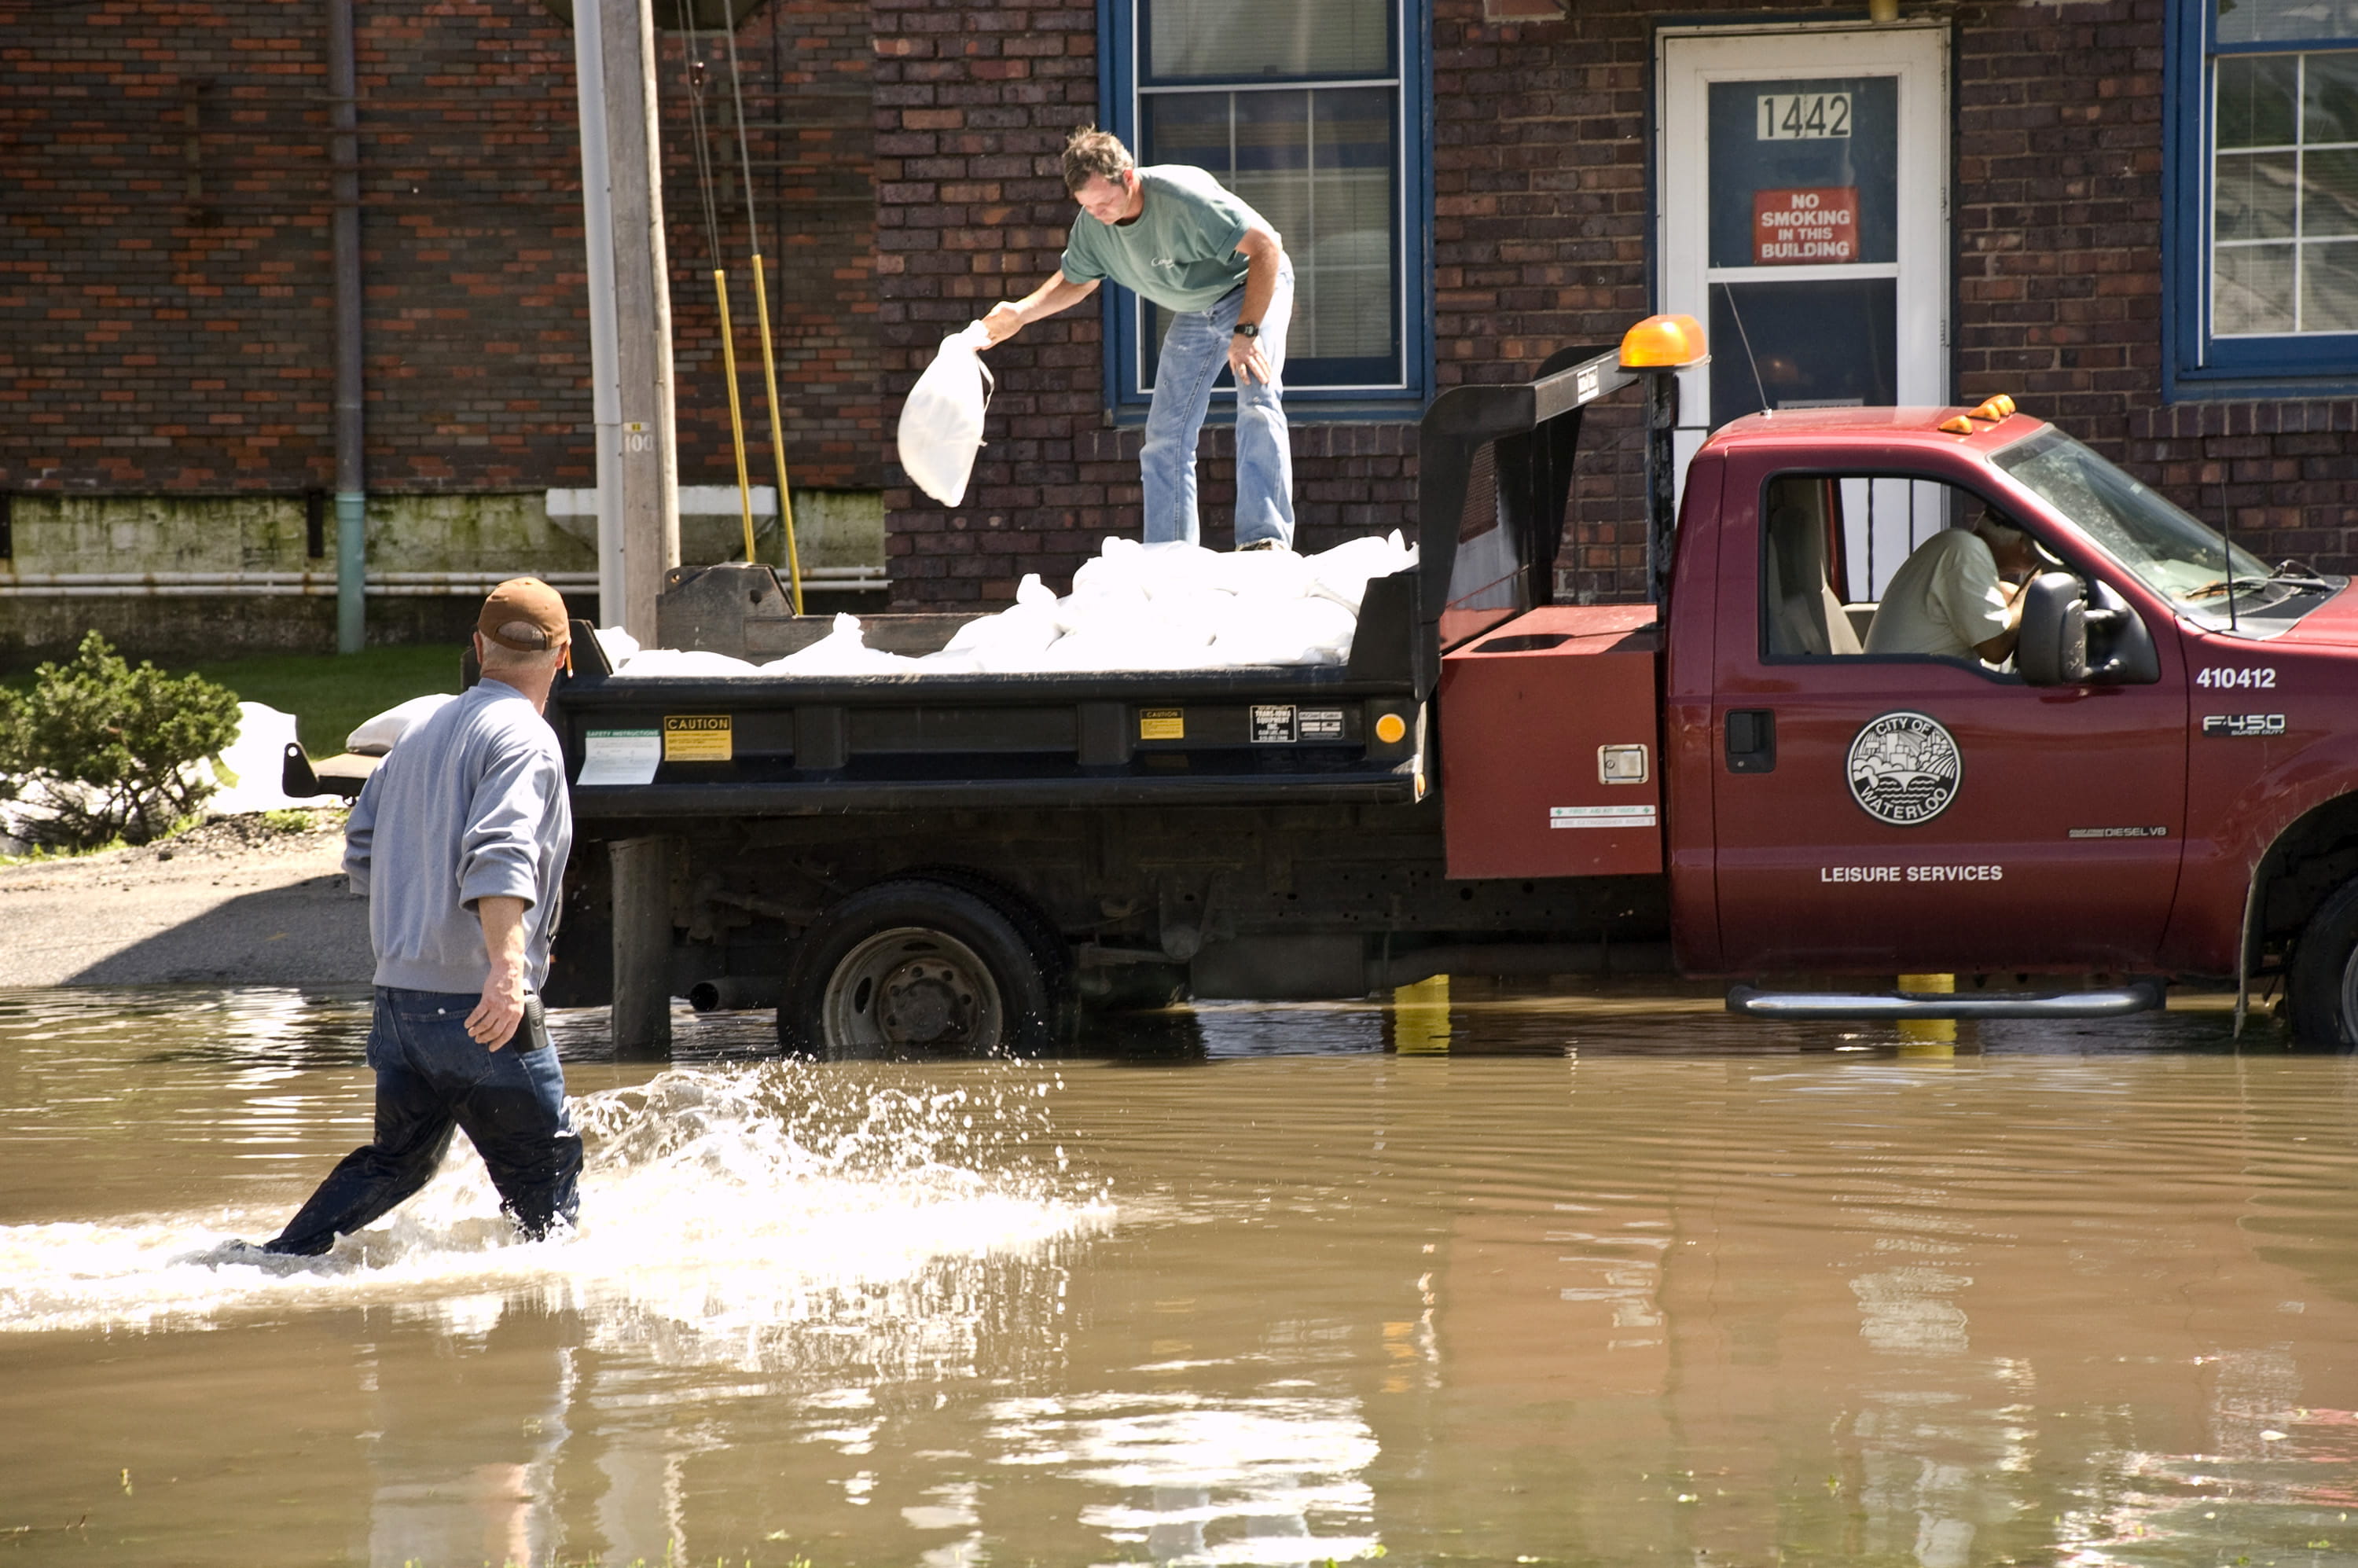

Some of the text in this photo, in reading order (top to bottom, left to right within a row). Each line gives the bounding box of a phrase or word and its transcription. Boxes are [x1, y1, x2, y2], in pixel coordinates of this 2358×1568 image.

[1764, 95, 1849, 138] 1442
[1791, 193, 1820, 209] NO
[1761, 209, 1850, 227] SMOKING
[1778, 227, 1833, 241] IN THIS
[1761, 241, 1849, 258] BUILDING
[2196, 667, 2276, 688] 410412
[667, 718, 728, 729] CAUTION
[1875, 718, 1932, 736] CITY OF
[2202, 714, 2286, 732] F-450
[1860, 786, 1948, 820] WATERLOO
[2105, 828, 2149, 837] DIESEL
[2150, 827, 2167, 836] V8
[1820, 865, 2004, 883] LEISURE SERVICES
